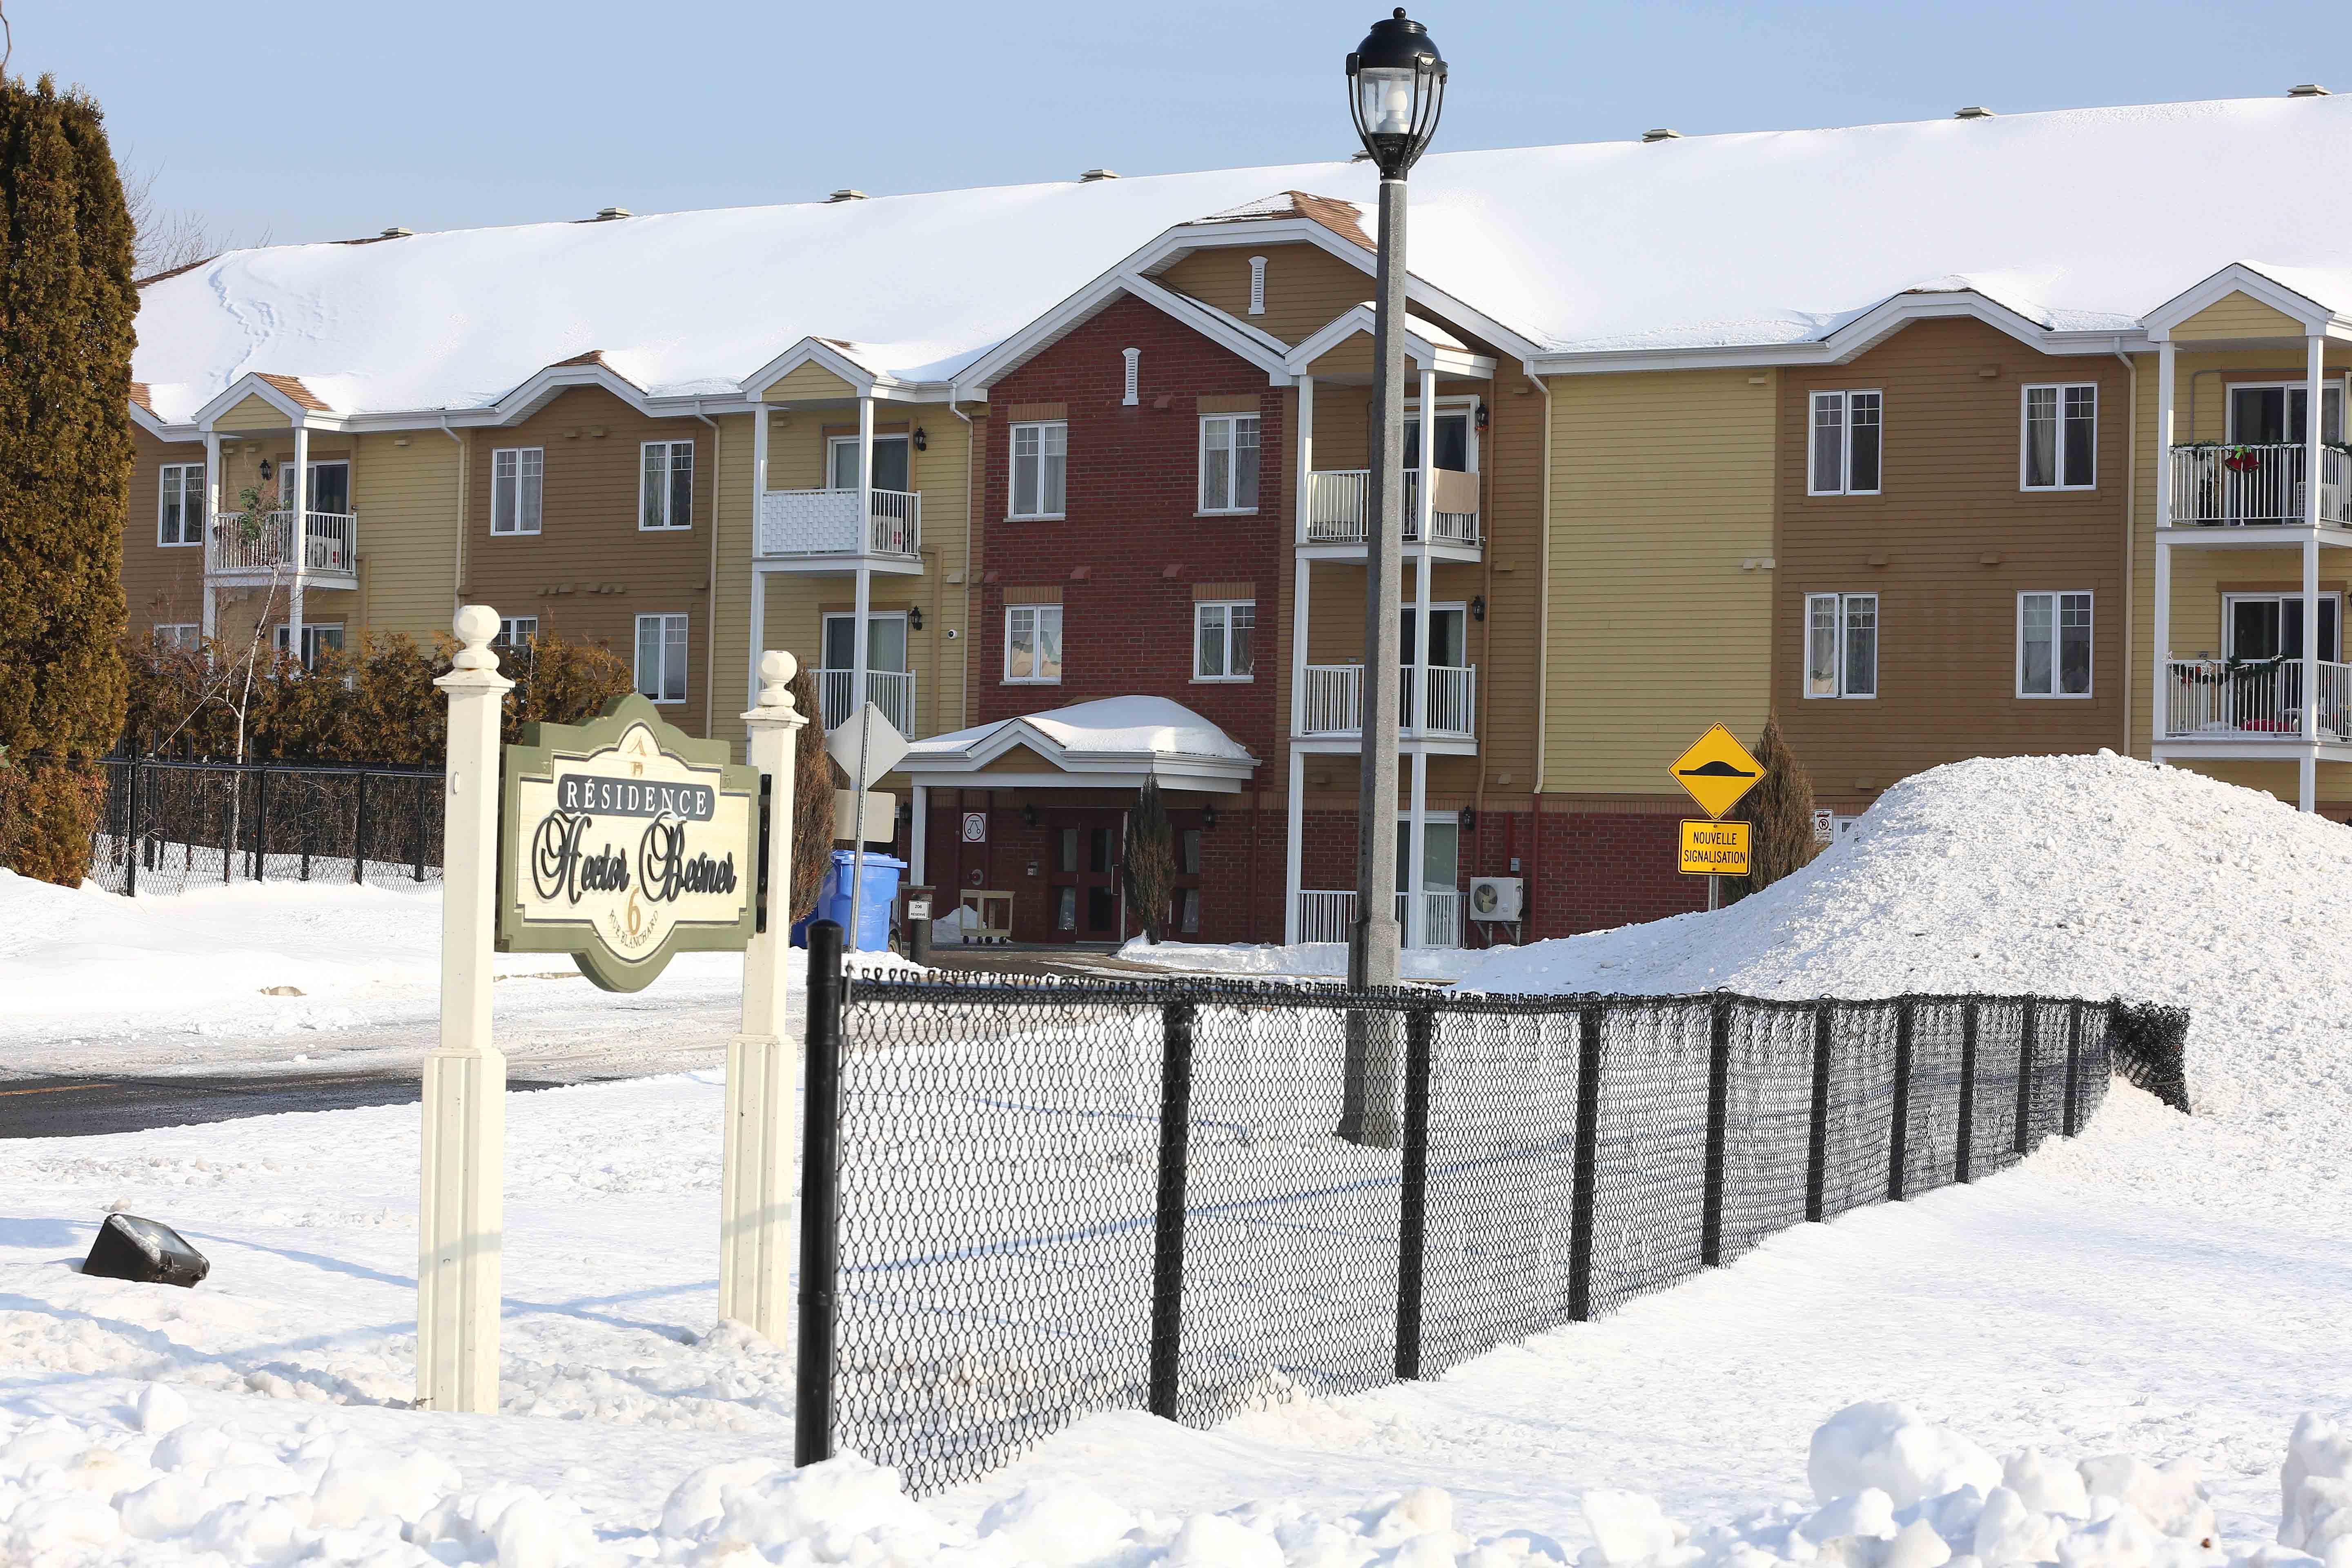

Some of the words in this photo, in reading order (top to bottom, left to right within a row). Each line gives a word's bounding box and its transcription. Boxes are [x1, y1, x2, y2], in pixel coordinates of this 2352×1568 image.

[566, 778, 706, 815] RÉSIDENCE
[532, 810, 630, 904] Hector
[639, 811, 737, 902] Besner
[1684, 850, 1746, 864] SIGNALISATION
[1693, 832, 1737, 845] NOUVELLE
[610, 909, 621, 937] RUE
[621, 910, 658, 949] BLANCHARD
[628, 886, 640, 935] 6
